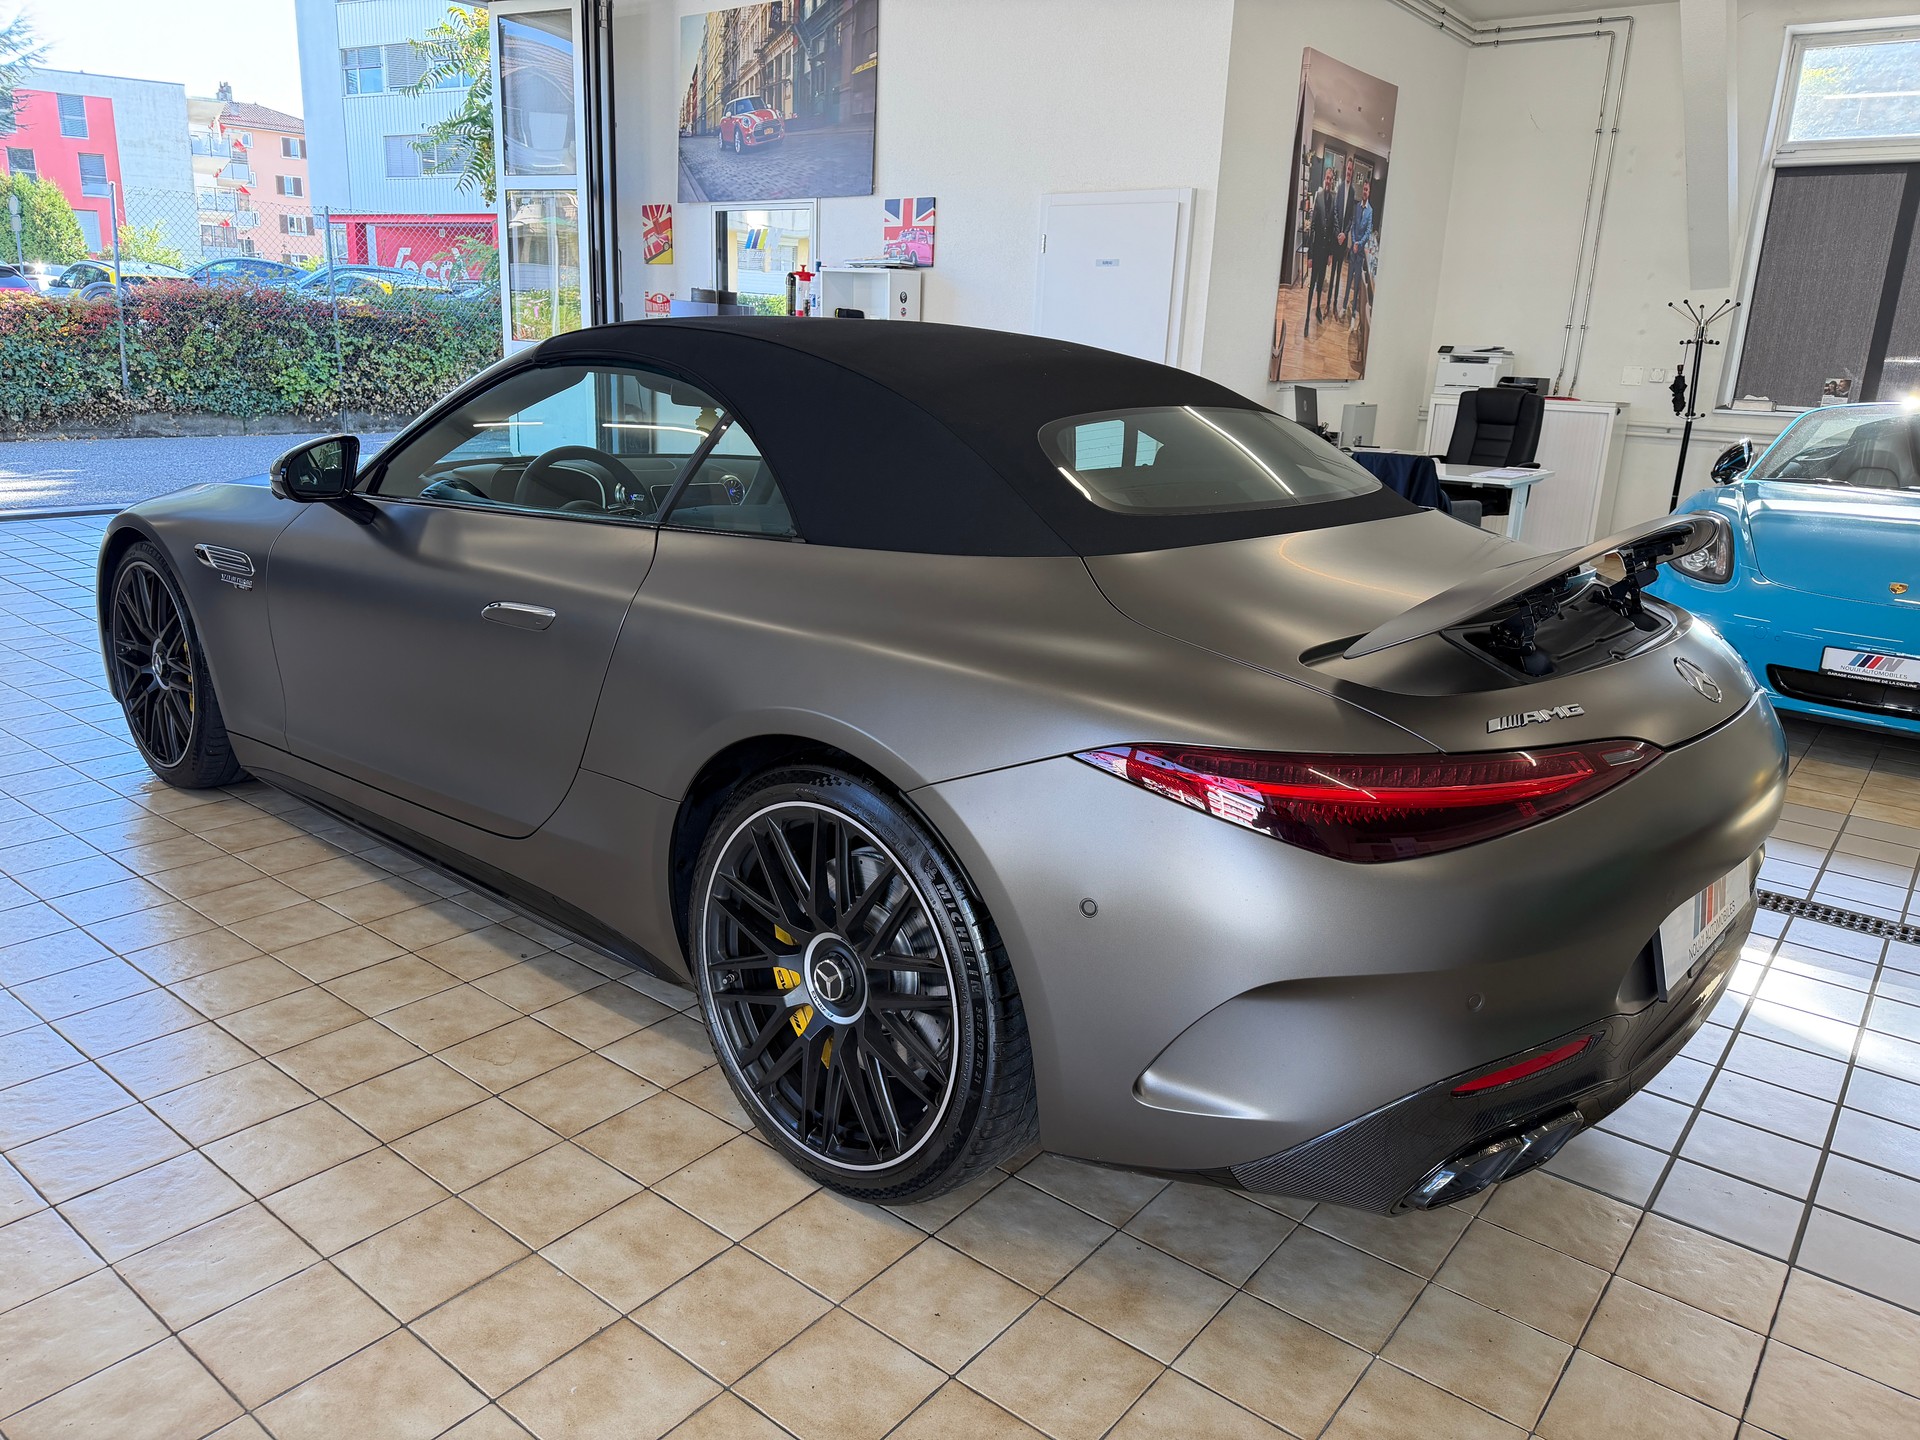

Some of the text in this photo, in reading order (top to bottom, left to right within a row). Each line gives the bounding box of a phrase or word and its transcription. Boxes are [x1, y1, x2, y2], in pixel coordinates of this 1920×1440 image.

[1861, 668, 1908, 680] AUTOMOBILES
[1521, 703, 1585, 727] AMG
[1705, 900, 1736, 943] AUTOMOBILES
[936, 883, 983, 996] MICHELIN
[976, 1054, 984, 1068] ZR
[974, 1072, 983, 1086] 21
